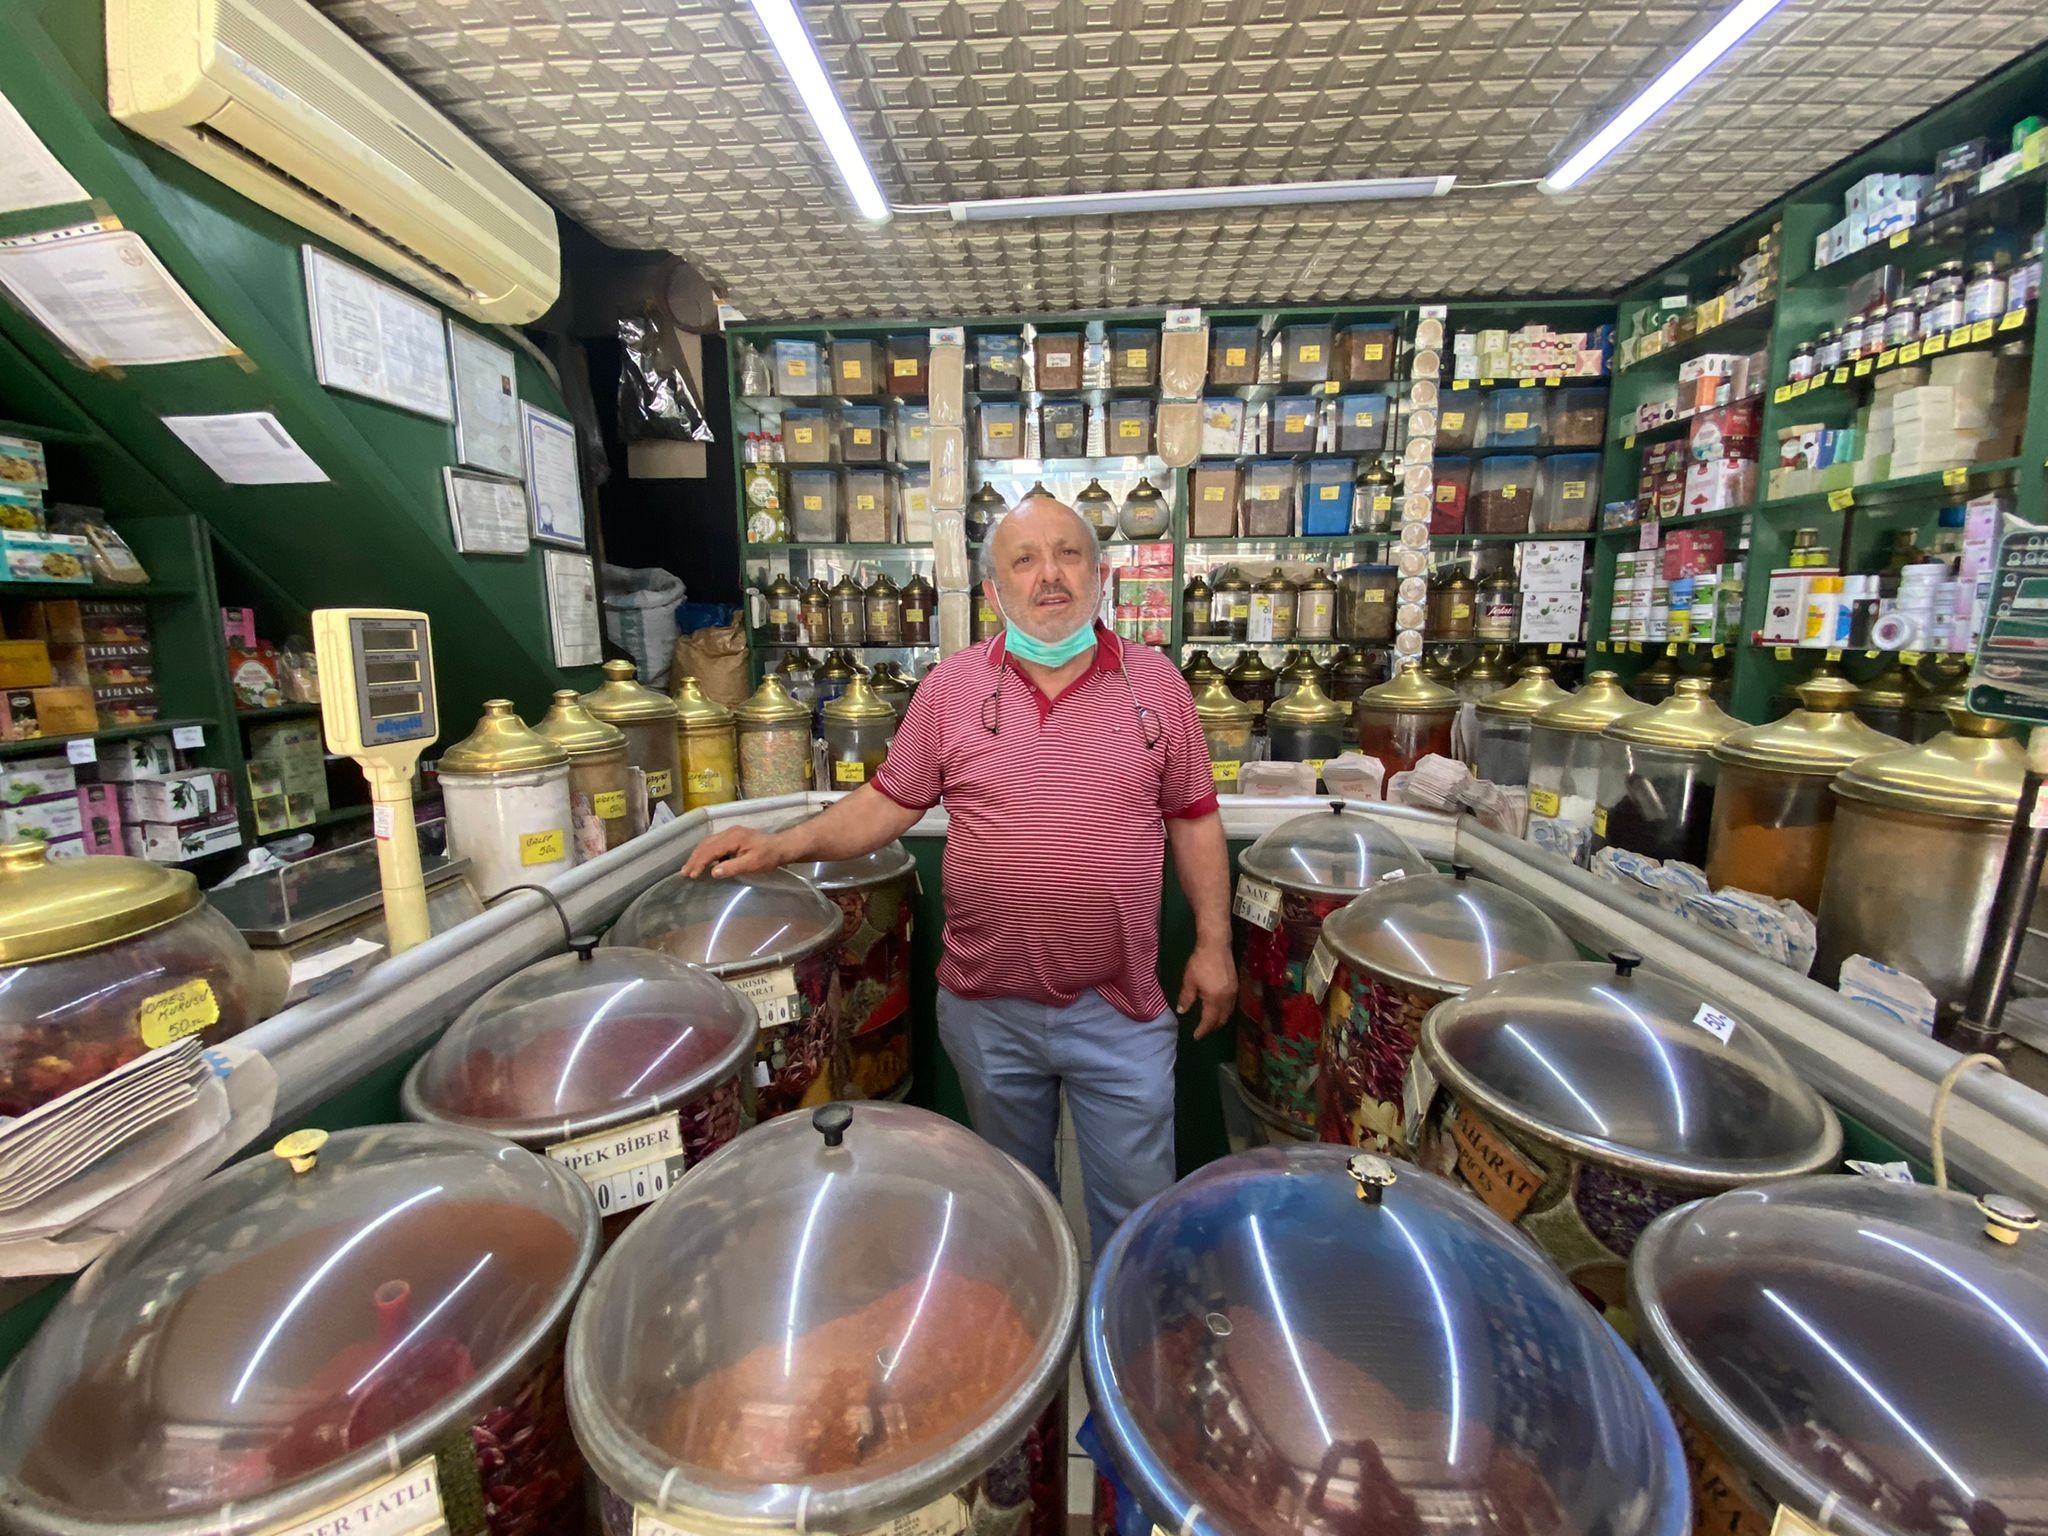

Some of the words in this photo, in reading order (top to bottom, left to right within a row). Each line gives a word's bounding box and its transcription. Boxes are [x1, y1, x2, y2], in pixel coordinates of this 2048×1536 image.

[1246, 884, 1270, 902] NANE
[564, 1147, 609, 1170] İPEK
[615, 1129, 670, 1156] BİBER
[356, 1477, 432, 1523] TATLI
